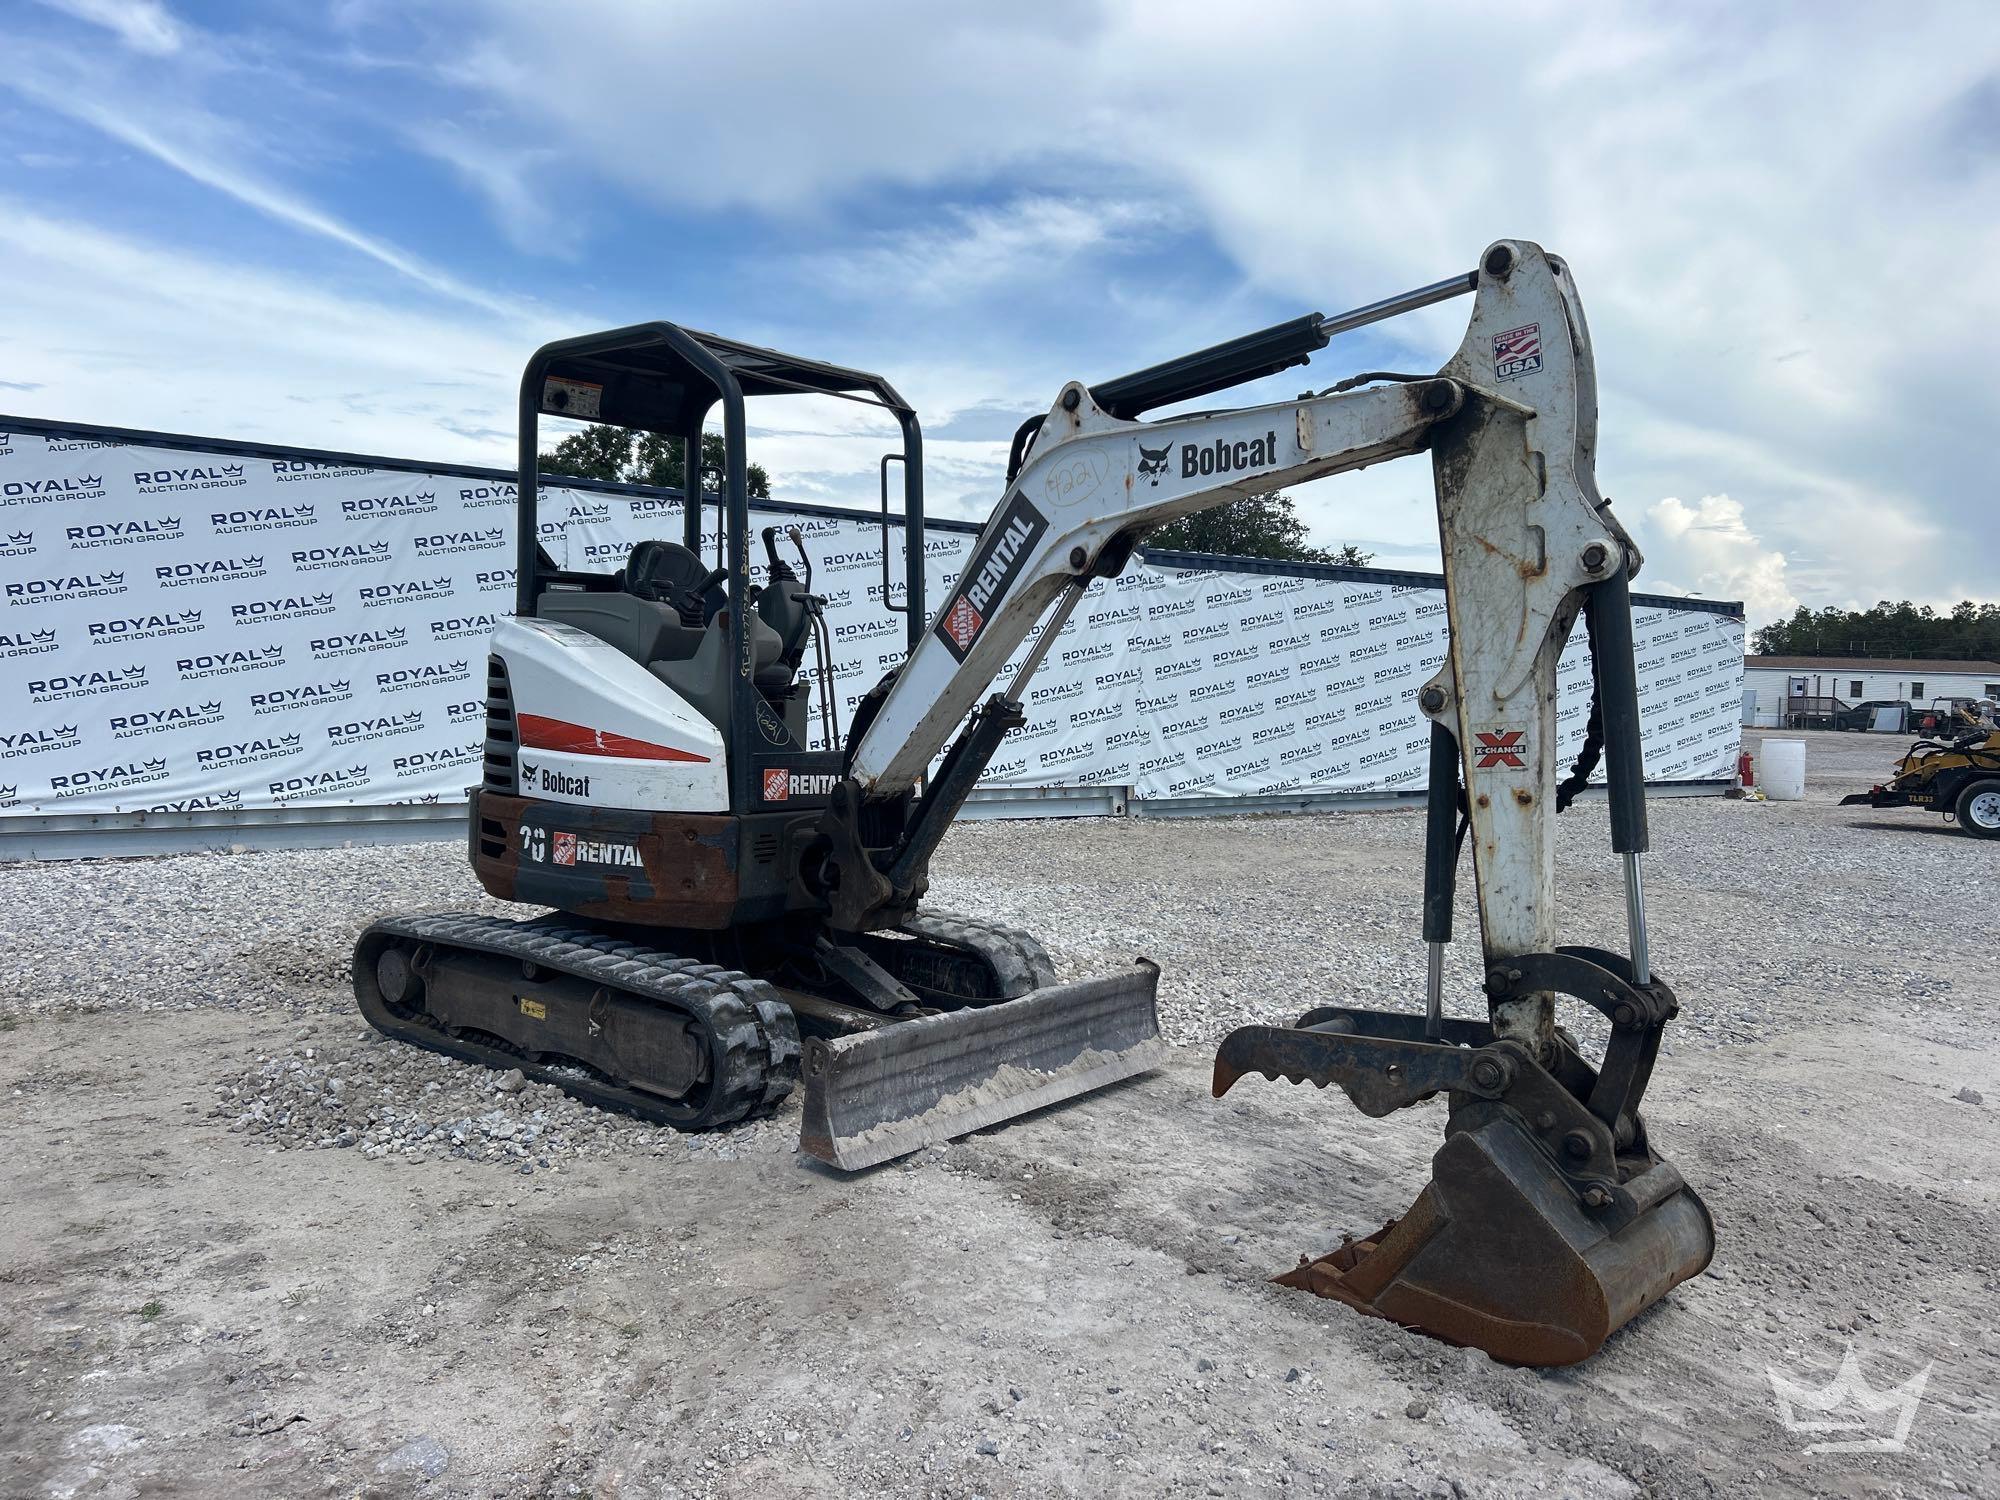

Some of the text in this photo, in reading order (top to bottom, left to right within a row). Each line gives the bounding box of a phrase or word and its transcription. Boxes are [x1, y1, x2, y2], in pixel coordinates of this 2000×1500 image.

[1498, 357, 1538, 376] USA
[1182, 431, 1276, 478] Bobcat
[134, 467, 222, 485] ROYAL
[276, 472, 331, 482] AUCTION
[333, 464, 375, 477] GROUP
[0, 479, 79, 497] OYAL
[139, 480, 247, 493] AUCTION GROUP
[460, 485, 518, 500] ROYA
[56, 491, 106, 502] GROUP
[342, 495, 417, 512] ROYAL
[463, 498, 511, 509] AUCTION
[211, 507, 294, 526] ROYAL
[345, 506, 438, 521] AUCTION GROUP
[577, 516, 612, 525] GROUP
[633, 510, 675, 520] AUCTION
[66, 520, 158, 540] ROYAL
[215, 519, 318, 534] AUCTION GROUP
[812, 530, 841, 539] GROUP
[71, 532, 184, 549] AUCTION GROUP
[414, 531, 485, 548] ROYAL
[292, 545, 370, 563] ROYAL
[418, 542, 505, 557] AUCTION GROUP
[296, 555, 392, 572] AUCTION GROUP
[823, 551, 874, 566] ROYAL
[826, 561, 883, 573] AUCTION GROU
[968, 516, 1034, 612] RENTAL
[156, 559, 243, 579] ROYAL
[6, 575, 101, 597] ROYAL
[160, 570, 267, 588] AUCTION GROUP
[1262, 581, 1295, 592] ROYAL
[10, 587, 128, 606] AUCTION GROUP
[359, 581, 433, 600] ROYAL
[363, 590, 454, 608] AUCTION GROUP
[1344, 592, 1374, 604] ROYAL
[232, 597, 313, 617] ROYAL
[1149, 602, 1185, 615] ROYAL
[235, 607, 336, 625] AUCTION GROUP
[1241, 613, 1274, 626] ROYAL
[89, 614, 179, 636] ROYAL
[434, 619, 483, 641] AUCTION
[836, 621, 885, 637] ROYAL
[1183, 625, 1219, 639] ROYAL
[1684, 623, 1704, 633] ROYAL
[93, 625, 205, 645] AUCTION GROUP
[310, 631, 387, 652] ROYAL
[838, 629, 899, 643] AUCTION GROUP
[1396, 634, 1425, 646] ROYAL
[1652, 632, 1673, 643] ROYAL
[7, 644, 59, 657] GROUP
[314, 640, 408, 660] AUCTION GROUP
[1063, 646, 1101, 661] ROYAL
[177, 650, 262, 672] ROYAL
[181, 659, 286, 680] AUCTION GROUP
[1155, 661, 1191, 675] ROYAL
[1300, 657, 1331, 671] ROYAL
[376, 664, 450, 685] ROYAL
[836, 670, 864, 681] GROUP
[1247, 669, 1280, 684] ROYAL
[1687, 666, 1707, 677] ROYAL
[28, 670, 123, 694] ROYAL
[380, 673, 470, 693] AUCTION GROUP
[33, 680, 149, 703] AUCTION GROUP
[251, 684, 330, 707] ROYAL
[1031, 684, 1072, 700] ROYAL
[254, 693, 353, 715] AUCTION GROUP
[1641, 703, 1662, 714] ROYAL
[110, 706, 200, 730] ROYAL
[1162, 719, 1198, 734] ROYAL
[1305, 711, 1337, 725] ROYAL
[114, 715, 225, 739] AUCTION GROUP
[328, 716, 403, 738] ROYAL
[331, 724, 425, 746] AUCTION GROUP
[31, 740, 82, 754] GROUP
[1332, 731, 1362, 746] ROYAL
[197, 738, 280, 763] ROYAL
[393, 747, 466, 770] ROYAL
[1039, 745, 1082, 762] ROYAL
[1360, 750, 1389, 764] ROYAL
[1475, 745, 1525, 755] X-CHANGE
[1693, 751, 1712, 762] ROYAL
[201, 747, 303, 771] AUCTION GROUP
[51, 763, 144, 790] ROYAL
[397, 763, 446, 777] AUCTION
[1226, 761, 1260, 776] ROYAL
[55, 772, 170, 799] AUCTION GROUP
[269, 770, 348, 795] ROYAL
[273, 778, 370, 803] AUCTION GROUP
[543, 769, 590, 797] Bobcat
